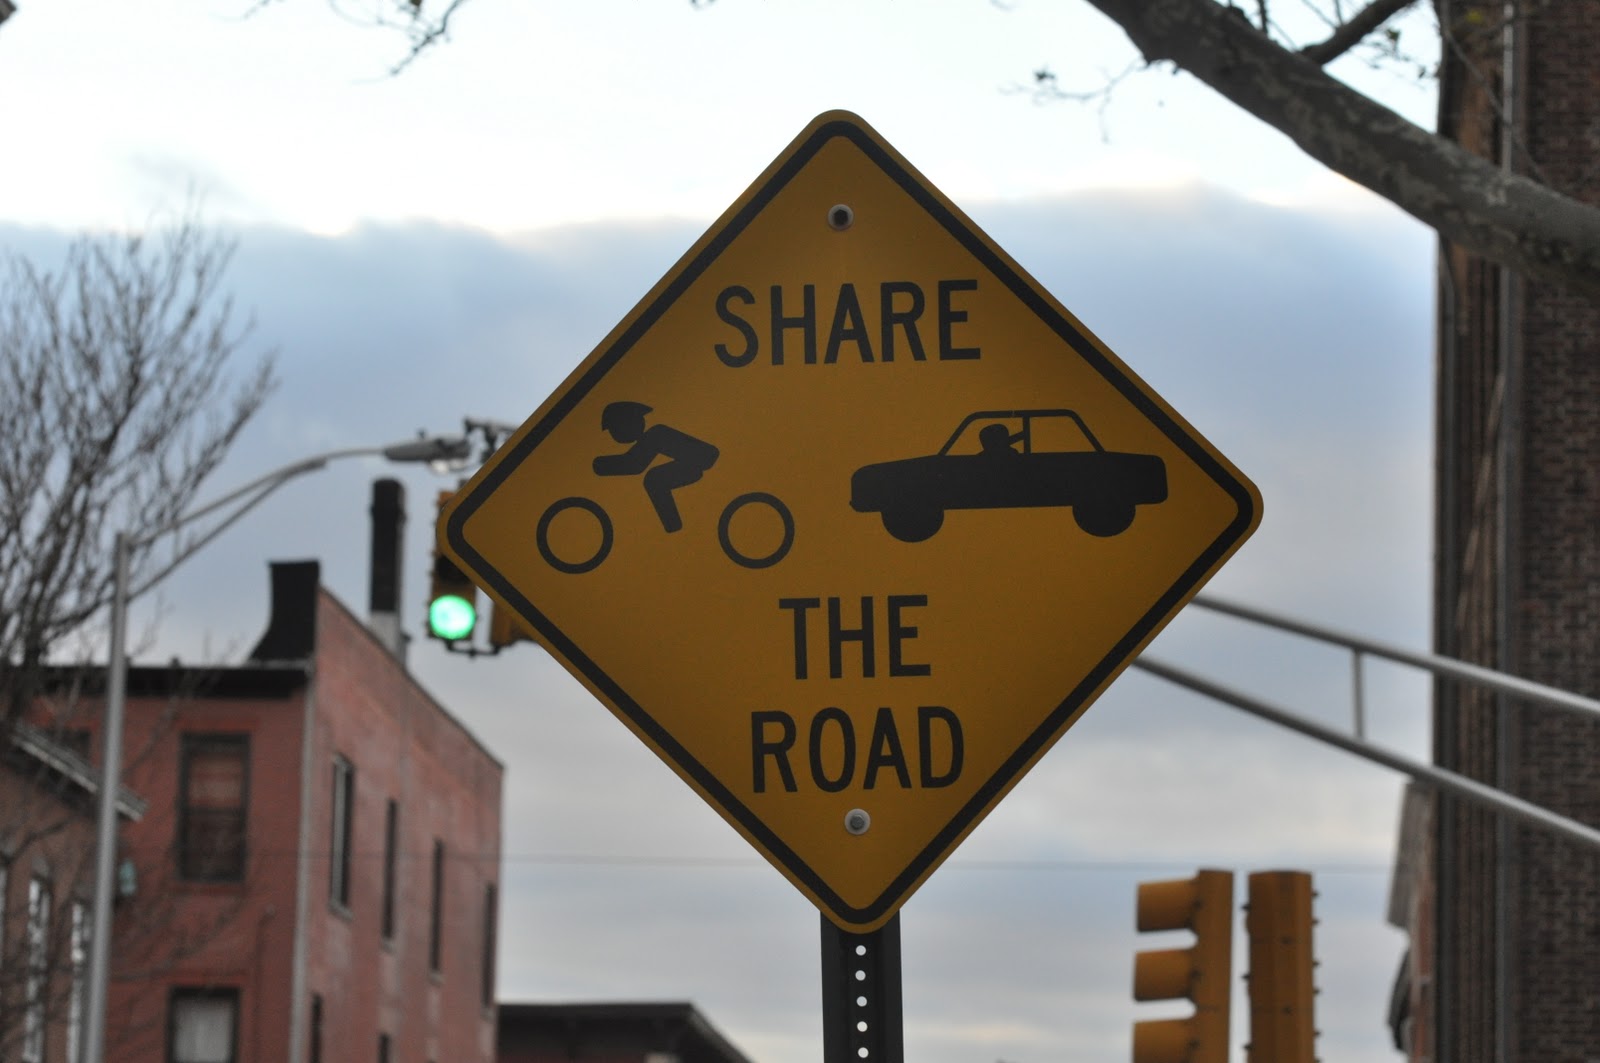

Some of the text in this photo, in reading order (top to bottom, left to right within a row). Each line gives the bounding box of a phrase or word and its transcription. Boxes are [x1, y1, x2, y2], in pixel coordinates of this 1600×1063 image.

[713, 278, 981, 368] SHARE
[778, 594, 932, 681] THE
[751, 705, 965, 794] ROAD
